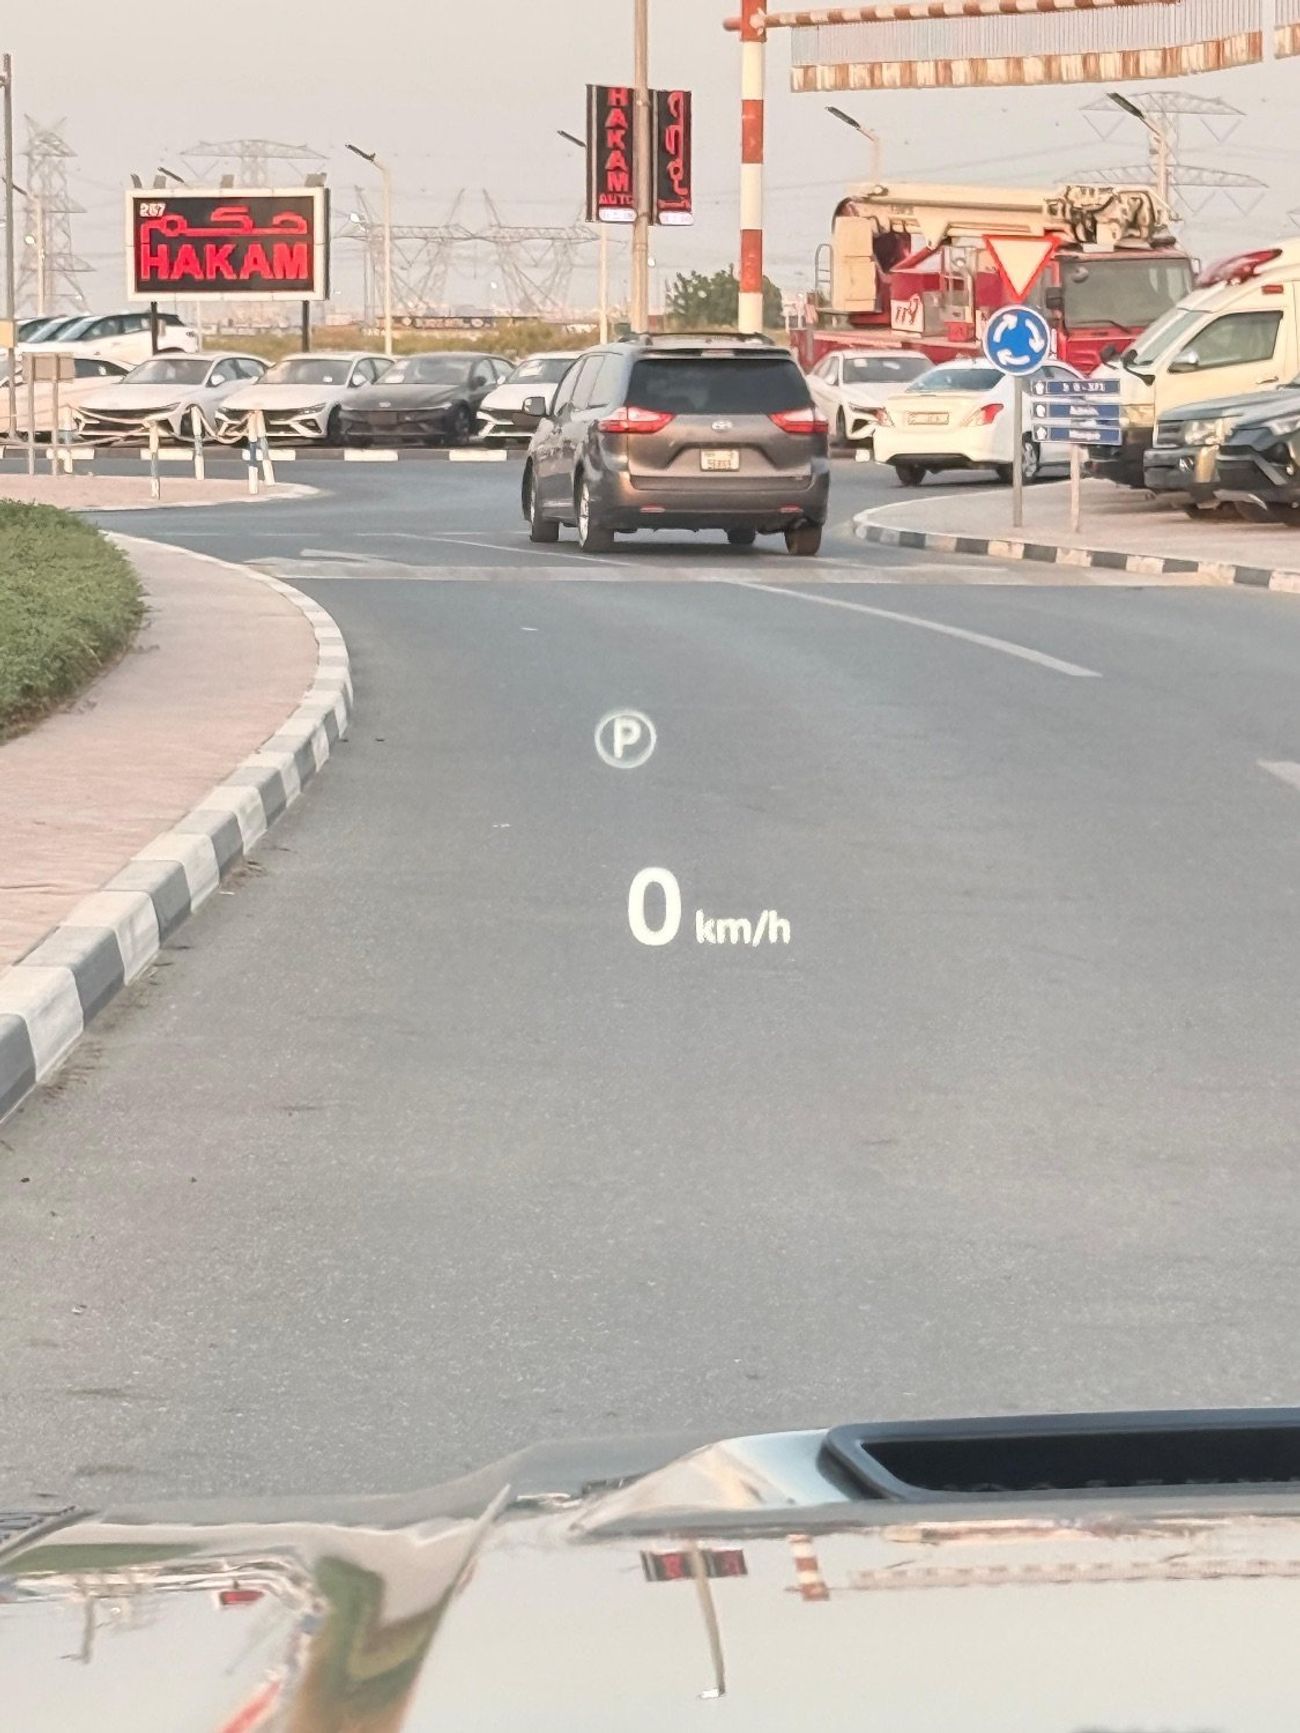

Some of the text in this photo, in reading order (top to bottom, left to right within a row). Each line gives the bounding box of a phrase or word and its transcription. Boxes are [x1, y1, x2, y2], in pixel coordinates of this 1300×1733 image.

[605, 87, 629, 192] HAKAM
[140, 206, 308, 243] حكم
[140, 242, 308, 279] HAKAM
[628, 867, 791, 947] 0 km/h
